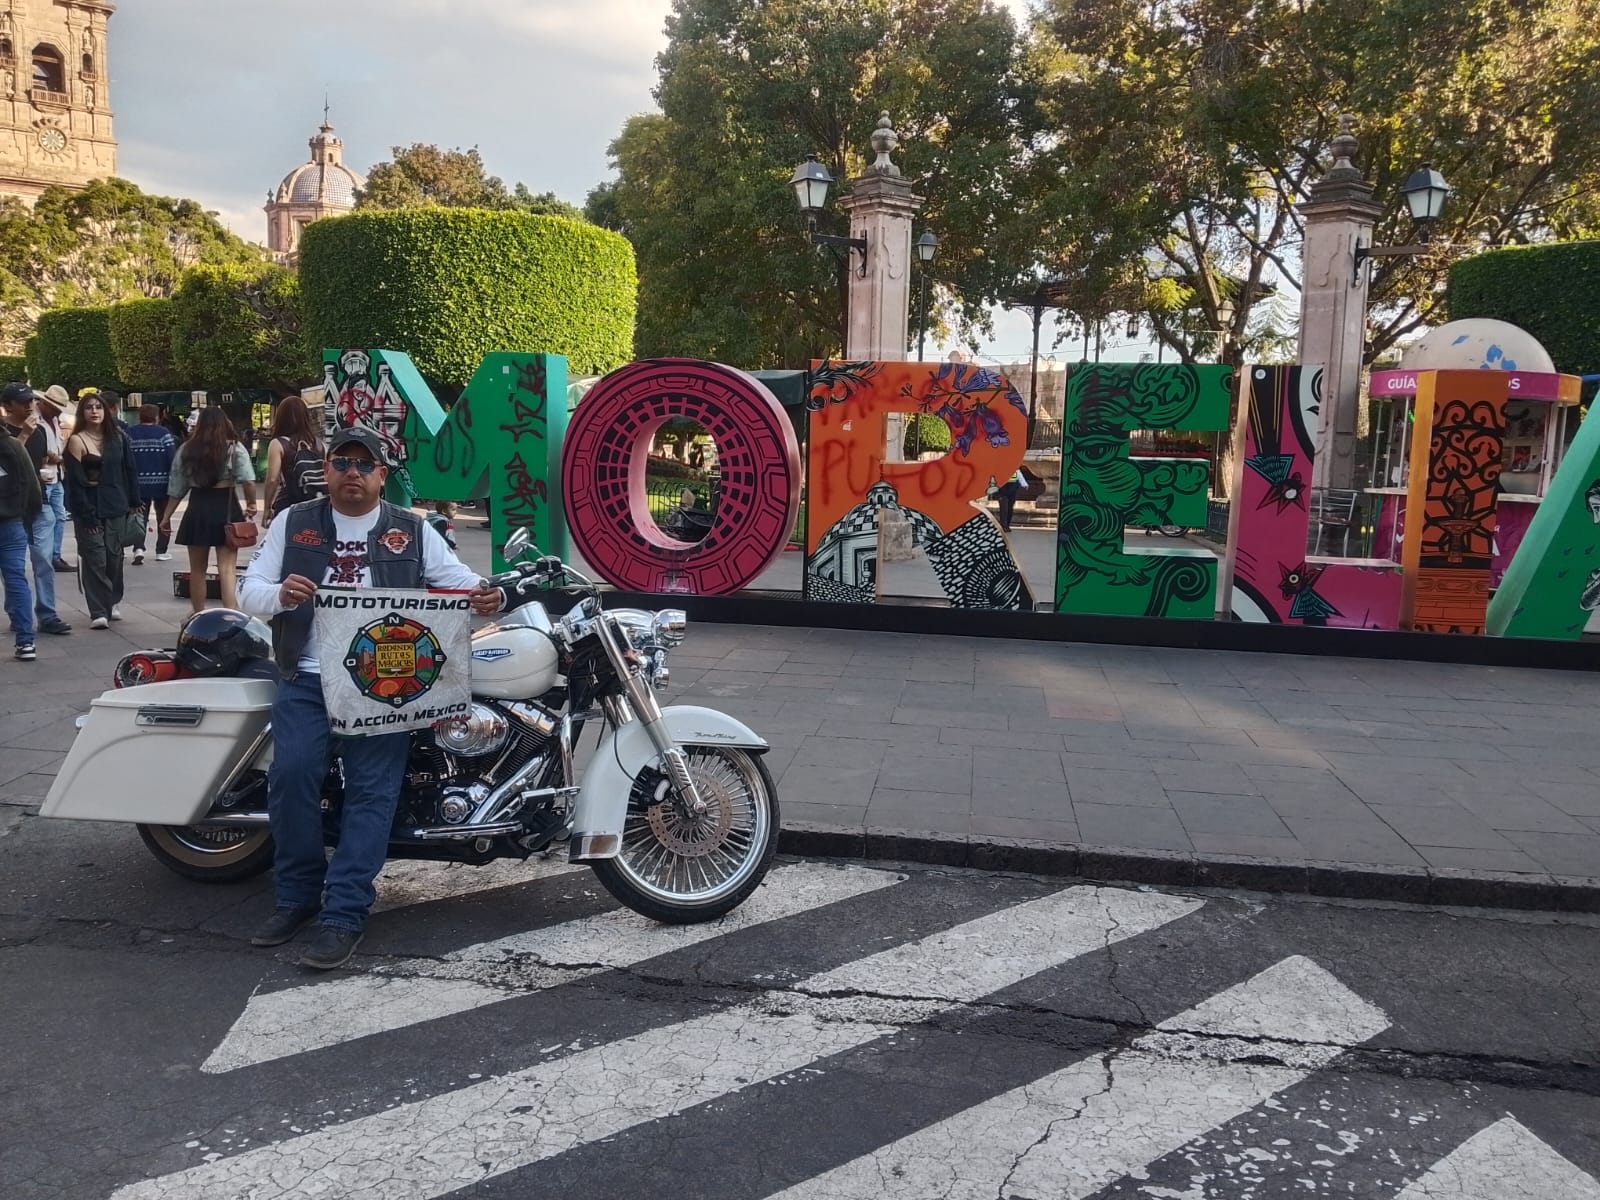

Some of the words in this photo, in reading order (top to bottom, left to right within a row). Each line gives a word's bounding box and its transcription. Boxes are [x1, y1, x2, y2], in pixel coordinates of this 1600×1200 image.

[1387, 374, 1418, 390] GUÍA
[335, 540, 367, 552] OCK
[328, 573, 365, 584] FEST
[314, 594, 471, 611] MOTOTURISMO
[389, 616, 400, 624] N
[346, 658, 357, 667] O
[352, 710, 408, 729] ACCIÓN
[414, 702, 467, 721] MÉXICO
